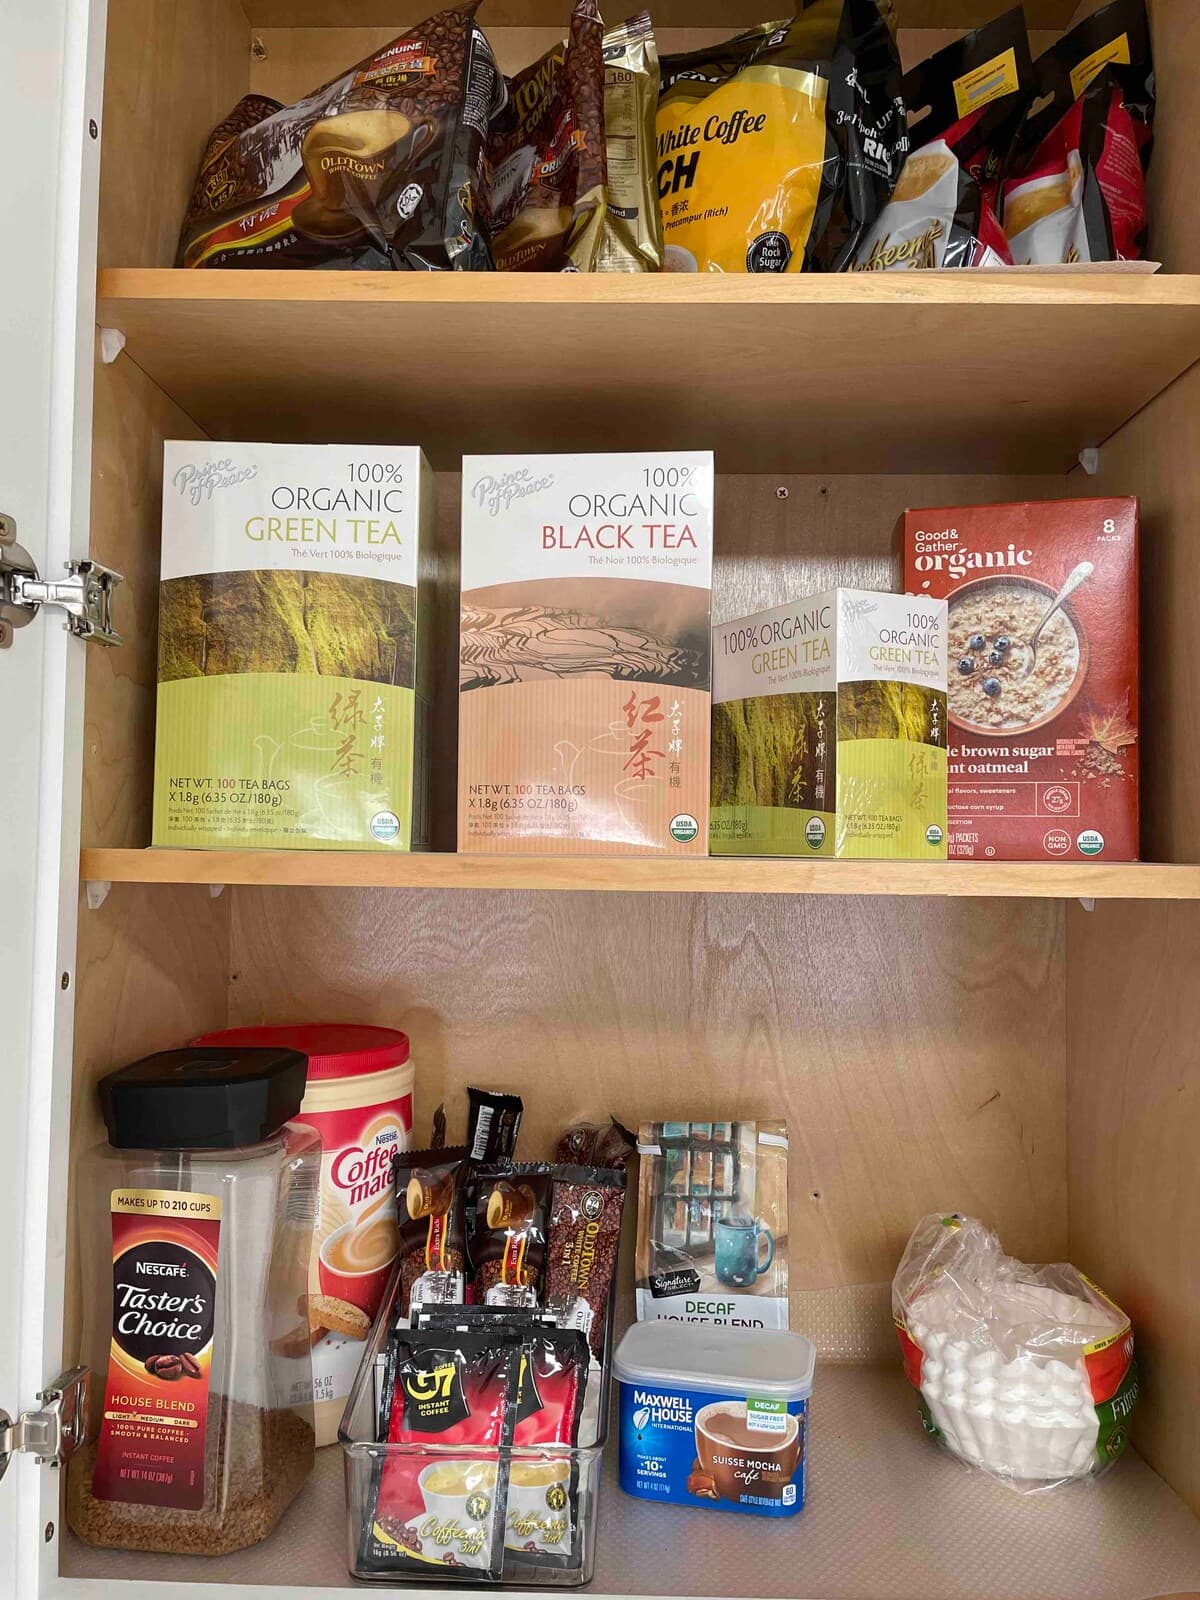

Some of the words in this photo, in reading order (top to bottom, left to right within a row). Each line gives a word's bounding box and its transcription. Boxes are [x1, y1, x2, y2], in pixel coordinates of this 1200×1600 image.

[612, 72, 628, 82] 180
[656, 124, 701, 157] White
[703, 109, 767, 145] Coffee
[657, 150, 701, 200] CH
[703, 206, 729, 221] (Rich)
[762, 247, 781, 257] Rock
[759, 256, 782, 269] Sugar
[173, 457, 238, 496] Prince
[347, 462, 403, 485] 100%
[643, 467, 699, 489] 100%
[471, 467, 535, 508] Prince
[271, 486, 403, 514] ORGANIC
[568, 493, 699, 518] ORGANIC
[244, 516, 338, 544] GREEN
[346, 519, 403, 545] TEA
[1103, 518, 1116, 534] 8
[541, 524, 635, 550] BLACK
[641, 524, 698, 550] TEA
[914, 528, 960, 541] Good&
[914, 541, 958, 554] Gather
[308, 548, 328, 560] Vert
[329, 549, 354, 561] 100%
[355, 550, 403, 563] Biologique
[605, 555, 624, 566] Noir
[626, 555, 650, 566] 100%
[651, 555, 698, 567] Biologique
[914, 543, 1034, 580] organic
[906, 612, 940, 631] 100%
[722, 624, 759, 656] 100%
[760, 605, 832, 646] ORGANIC
[878, 628, 940, 650] ORGANIC
[751, 643, 798, 675] GREEN
[801, 636, 832, 664] TEA
[869, 645, 912, 663] GREEN
[914, 649, 940, 667] TEA
[961, 744, 1012, 757] brown
[1012, 746, 1055, 760] sugar
[967, 760, 1029, 774] oatmeal
[168, 777, 192, 789] NET
[192, 778, 214, 790] WT.
[217, 779, 237, 790] 100
[239, 779, 260, 790] TEA
[262, 779, 291, 791] BAGS
[468, 784, 490, 796] NET
[491, 784, 512, 796] WT.
[515, 784, 534, 796] 100
[535, 784, 556, 796] TEA
[557, 785, 587, 796] BAGS
[168, 791, 177, 802] X
[178, 791, 200, 806] 1.8g
[200, 792, 228, 804] (6.35
[468, 798, 476, 809] X
[477, 798, 499, 812] 1.8g
[499, 799, 525, 811] (6.35
[675, 820, 693, 828] USDA
[955, 832, 979, 844] PACKETS
[1048, 835, 1067, 843] NON
[1082, 835, 1099, 843] USDA
[948, 844, 956, 856] OZ
[1047, 842, 1068, 850] GMO
[330, 1142, 399, 1190] Coffee
[349, 1169, 395, 1207] mate
[117, 1197, 145, 1208] MAKES
[146, 1199, 158, 1208] UP
[160, 1200, 171, 1210] TO
[172, 1200, 188, 1211] 210
[189, 1202, 212, 1213] CUPS
[577, 1221, 600, 1290] OLDTOWN
[570, 1253, 581, 1284] COFFEE
[654, 1275, 693, 1291] Signature
[116, 1283, 207, 1314] Taster's
[685, 1300, 736, 1315] DECAF
[117, 1311, 202, 1340] Choice
[313, 1377, 323, 1389] 56
[323, 1375, 333, 1387] OZ
[110, 1394, 152, 1408] HOUSE
[155, 1399, 196, 1412] BLEND
[418, 1399, 450, 1410] INSTANT
[633, 1390, 693, 1411] MAXWELL
[754, 1401, 781, 1410] DECAF
[140, 1415, 165, 1423] MEDIUM
[420, 1406, 449, 1417] COFFEE
[651, 1407, 693, 1423] HOUSE
[749, 1412, 769, 1421] SUGAR
[769, 1414, 785, 1422] FREE
[116, 1423, 134, 1431] 100%
[136, 1425, 155, 1433] PURE
[157, 1427, 185, 1436] COFFEE
[651, 1422, 694, 1433] INTERNATIONAL
[110, 1430, 141, 1438] SMOOTH
[150, 1433, 190, 1444] BALANCED
[121, 1451, 149, 1461] INSTANT
[149, 1453, 175, 1464] COFFEE
[712, 1455, 745, 1468] SUISSE
[746, 1459, 782, 1472] MOCHA
[636, 1468, 668, 1478] SERVINGS
[644, 1460, 659, 1471] 10
[734, 1468, 760, 1486] café
[458, 1540, 483, 1555] 3in1
